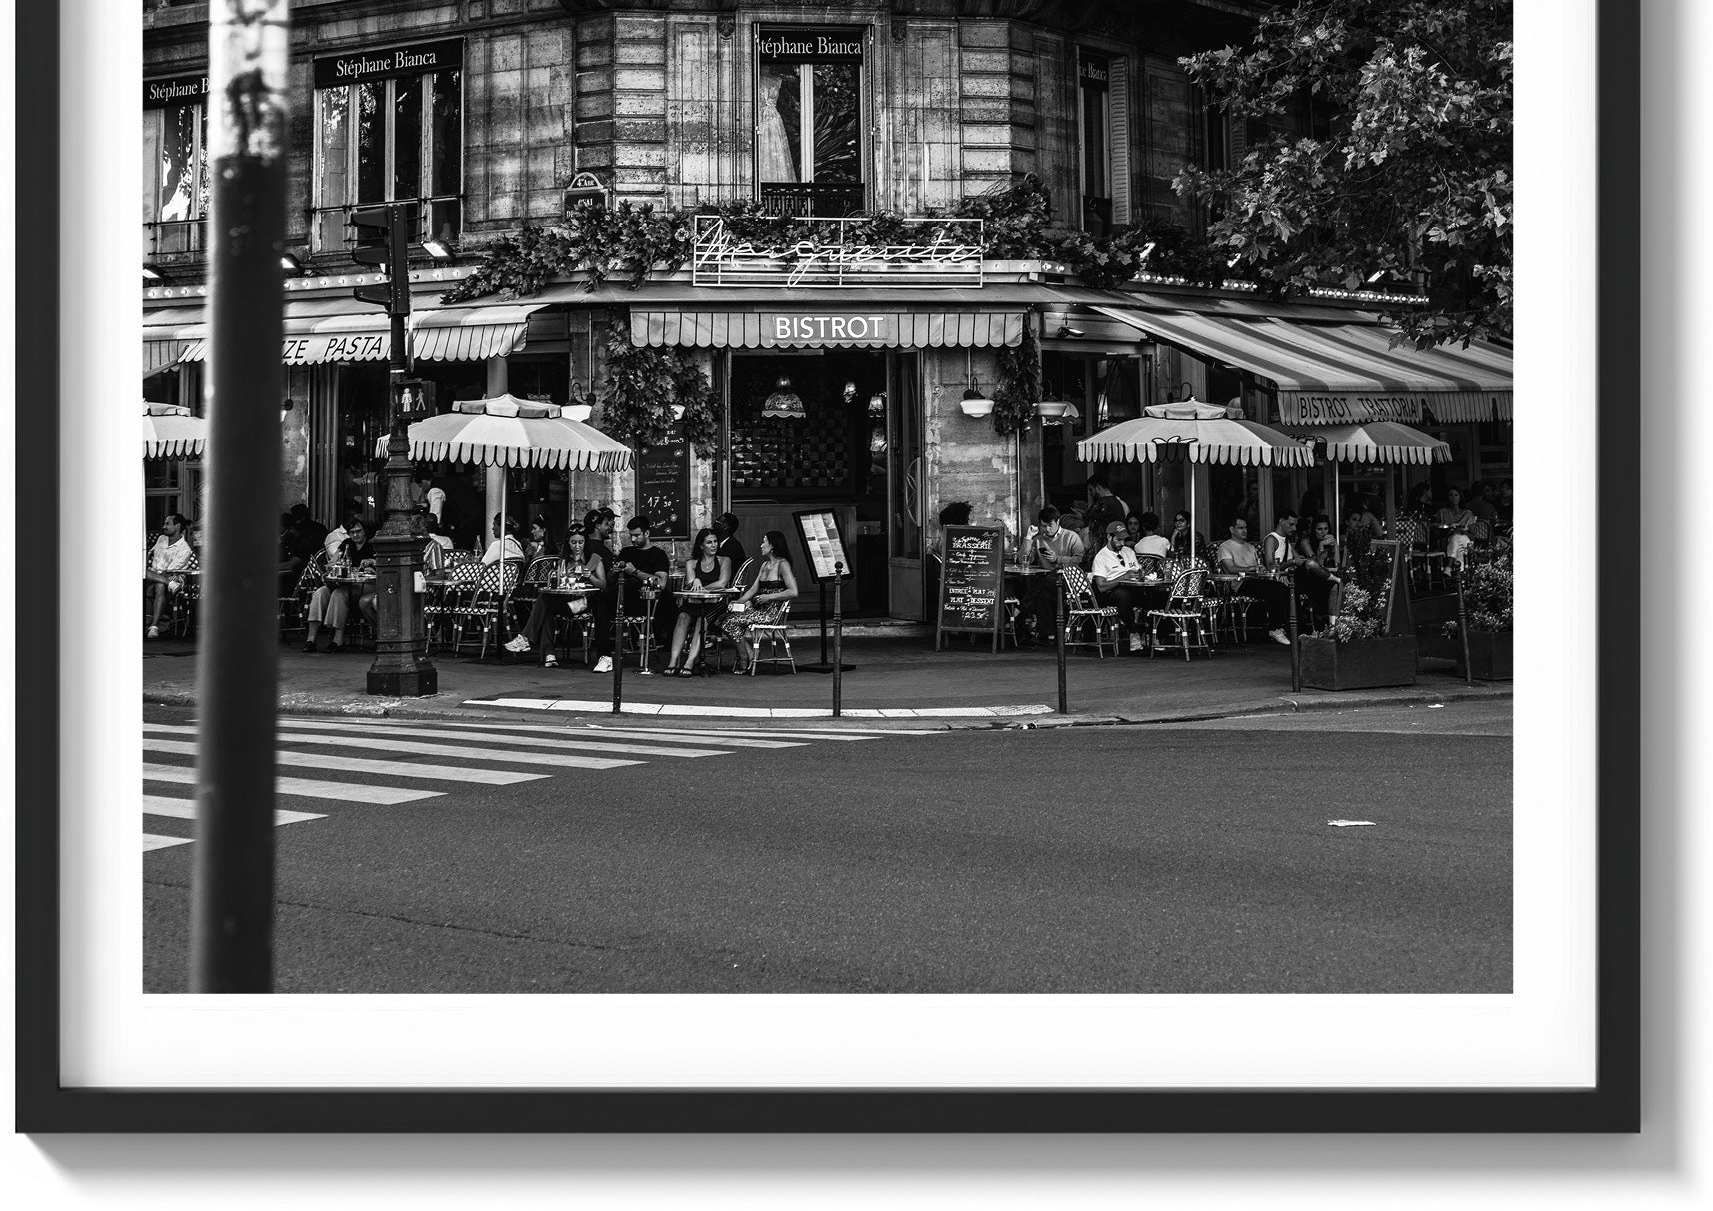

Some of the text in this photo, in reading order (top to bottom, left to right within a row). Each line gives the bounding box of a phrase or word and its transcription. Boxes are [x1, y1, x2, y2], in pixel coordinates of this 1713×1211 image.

[758, 36, 862, 59] téphane Bianca
[336, 50, 438, 79] Stéphane Bianca
[150, 81, 198, 102] Stéphane
[775, 315, 884, 340] BISTROT
[324, 335, 383, 359] PASTA
[1300, 396, 1418, 420] BISTROT TRATTORIA
